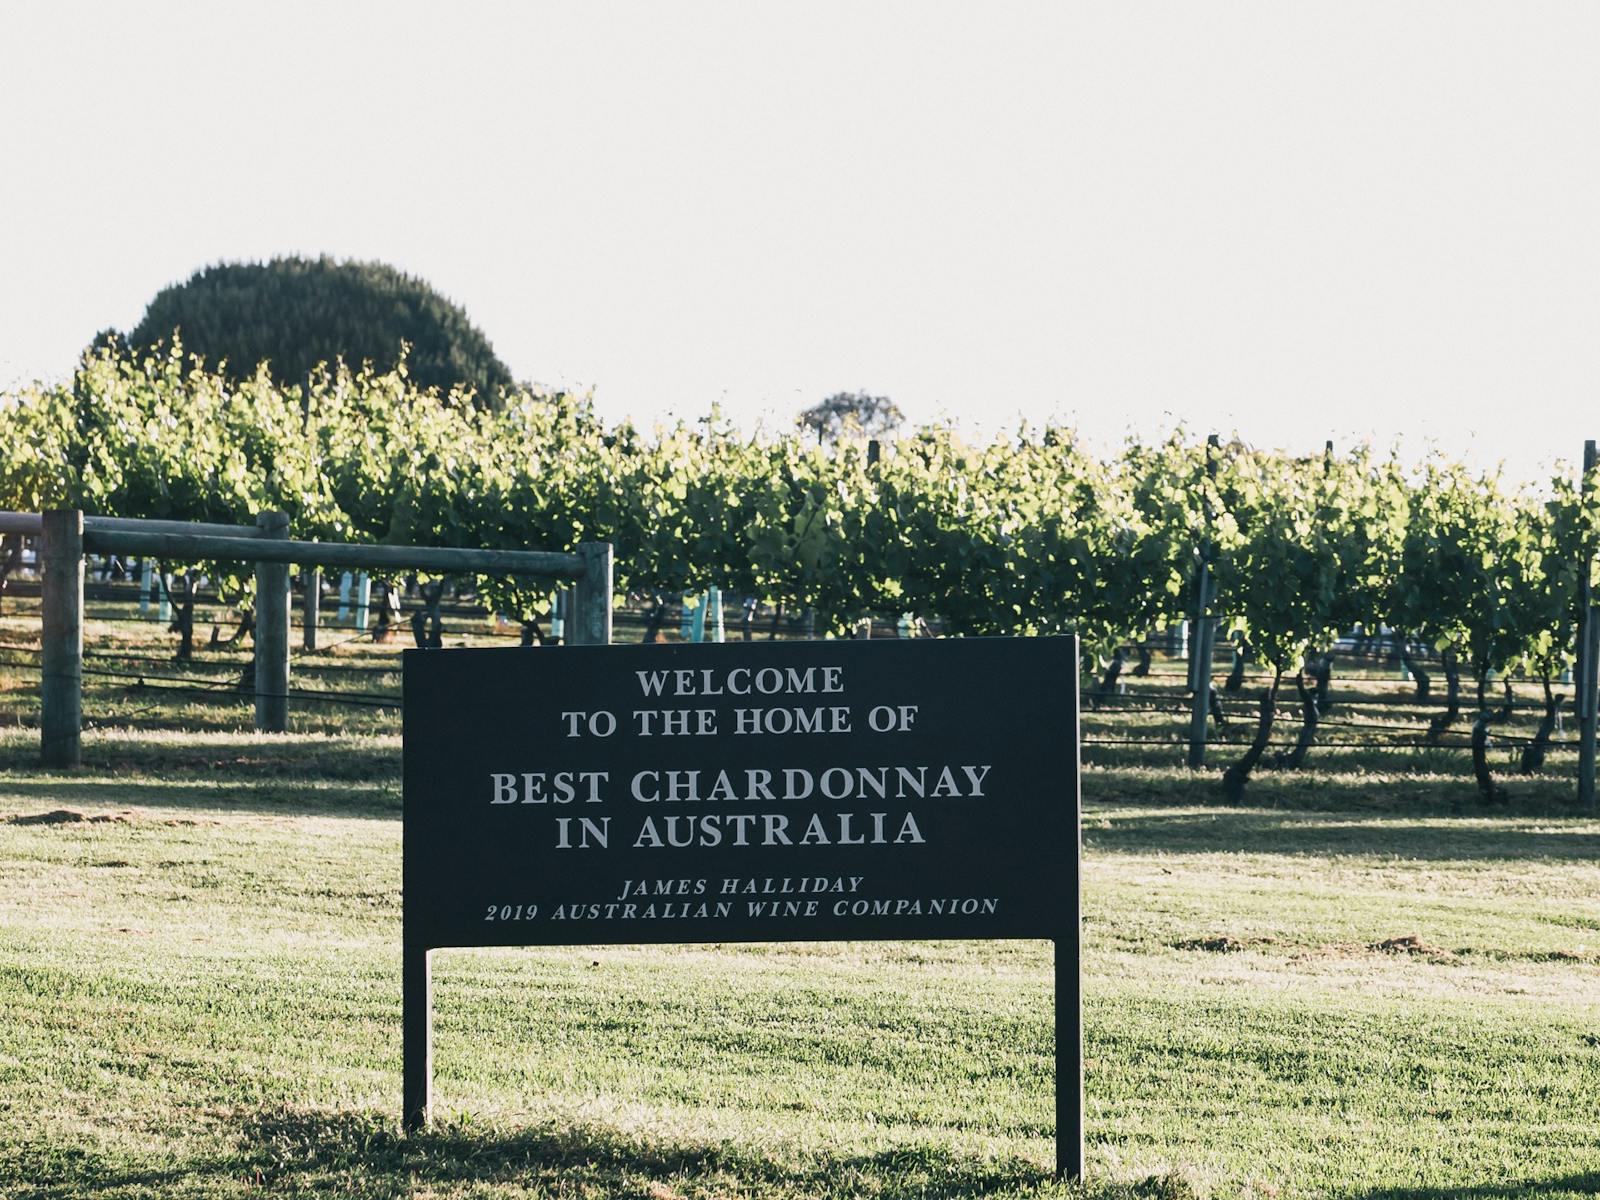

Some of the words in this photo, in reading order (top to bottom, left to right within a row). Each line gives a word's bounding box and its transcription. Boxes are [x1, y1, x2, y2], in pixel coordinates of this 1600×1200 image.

[635, 666, 845, 697] WELCOME
[561, 709, 617, 738] TO
[632, 708, 718, 737] THE
[733, 706, 853, 736] HOME
[867, 704, 920, 733] OF
[490, 770, 611, 805] BEST
[629, 765, 993, 803] CHARDONNAY
[555, 816, 612, 849] IN
[632, 811, 927, 848] AUSTRALIA
[617, 878, 707, 901] JAMES
[719, 874, 865, 894] HALLIDAY
[484, 904, 539, 923] 2019
[550, 902, 733, 921] AUSTRALIAN
[746, 900, 820, 919] WINE
[832, 897, 999, 918] COMPANION
